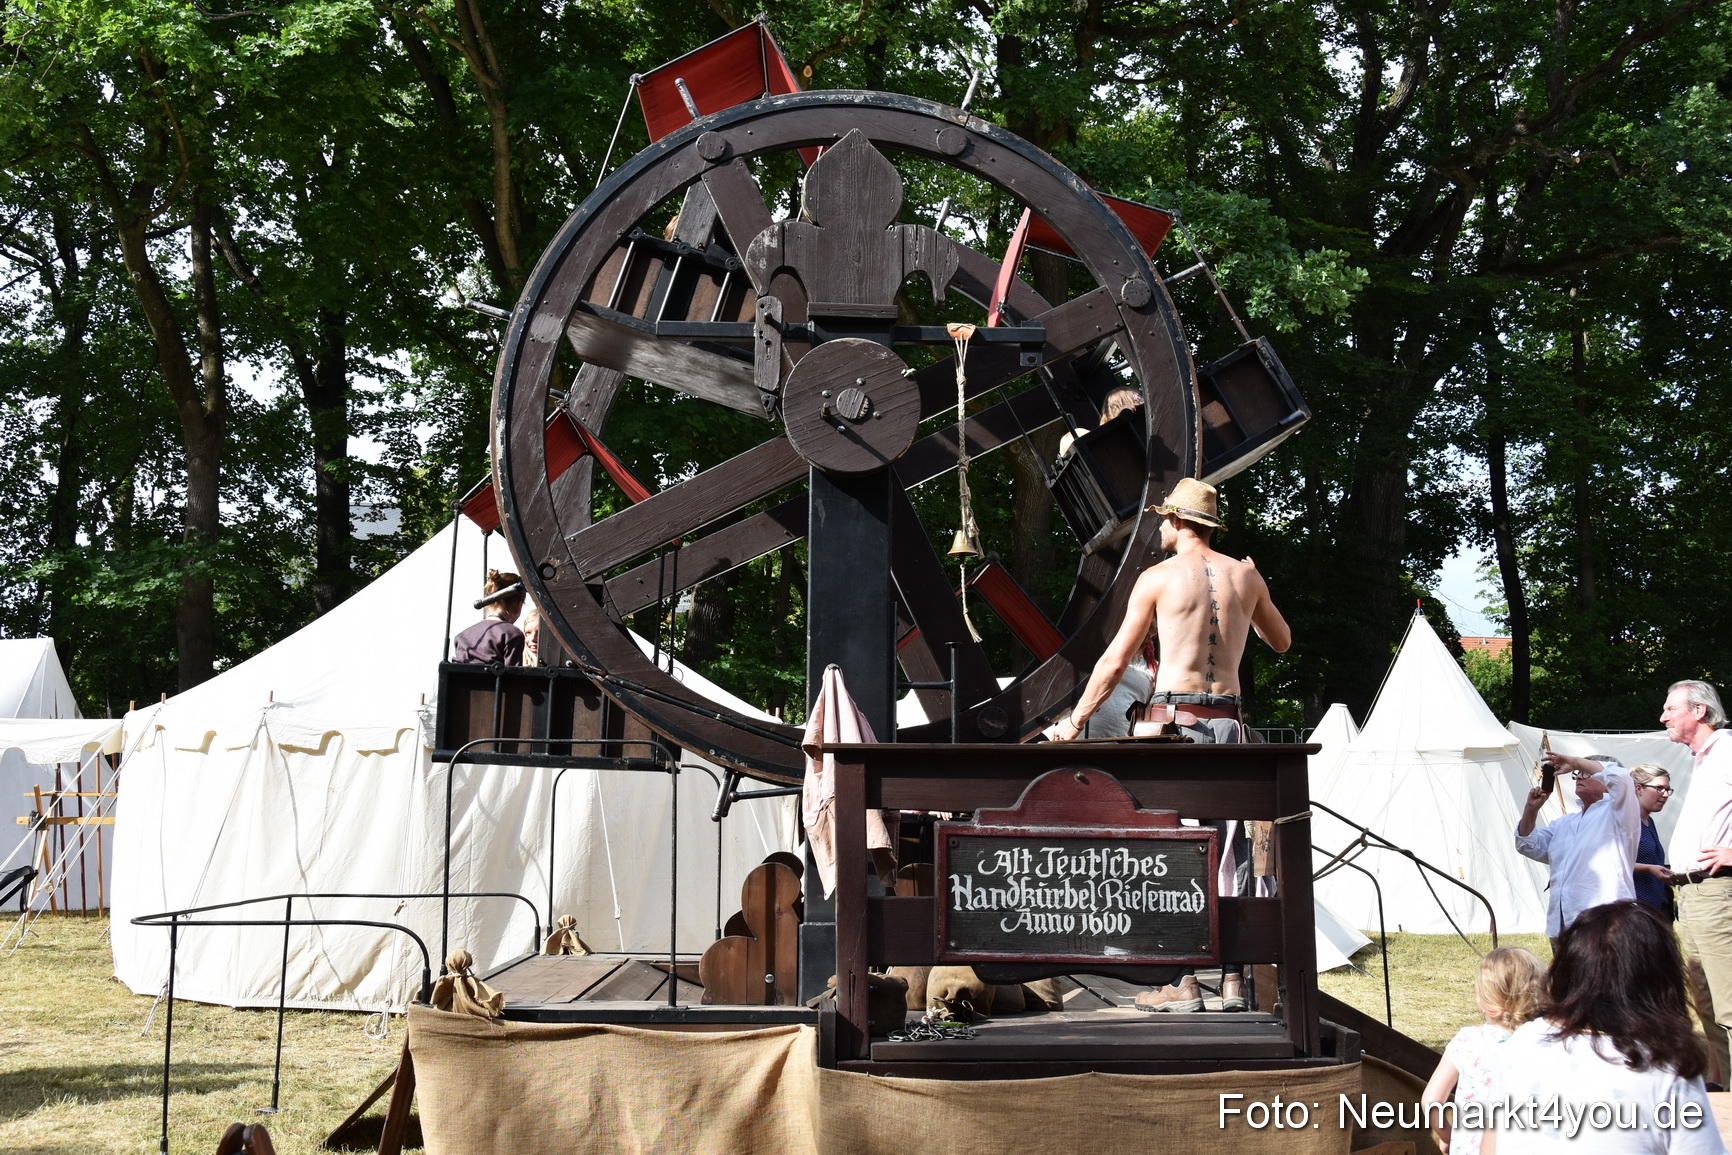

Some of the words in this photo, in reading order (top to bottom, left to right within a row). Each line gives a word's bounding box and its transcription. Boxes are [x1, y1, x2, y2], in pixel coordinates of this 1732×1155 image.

[978, 847, 1033, 878] Alt
[1000, 908, 1075, 935] Anno
[1079, 910, 1132, 937] 1600
